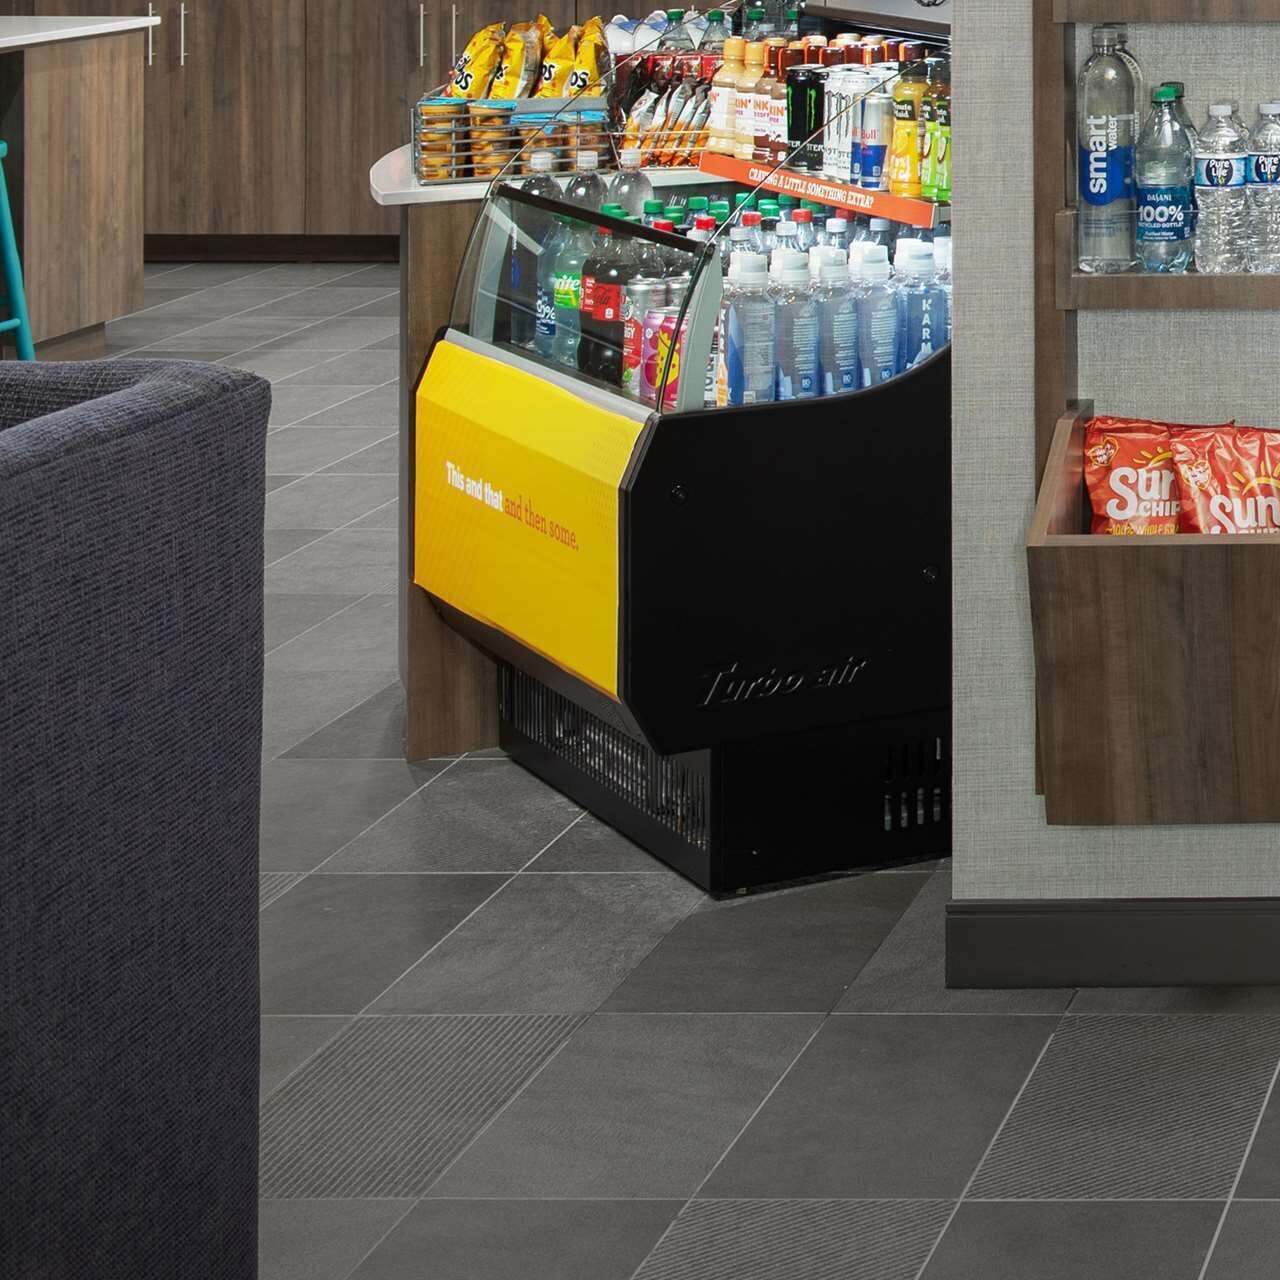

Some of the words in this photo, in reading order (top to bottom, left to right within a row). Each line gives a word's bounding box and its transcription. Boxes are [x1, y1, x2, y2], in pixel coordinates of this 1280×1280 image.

[1108, 116, 1118, 151] water
[1089, 115, 1107, 194] smart
[1210, 159, 1230, 169] Pure
[1259, 156, 1279, 166] Pure
[784, 177, 806, 194] LITTLE
[806, 182, 846, 203] SOMETHING
[1139, 205, 1184, 222] 100%
[446, 460, 465, 490] This
[466, 477, 483, 502] and
[484, 482, 504, 513] that
[505, 493, 522, 521] and
[525, 498, 548, 536] then
[550, 519, 579, 551] some.
[698, 662, 804, 707] Turbo
[813, 656, 868, 689] air
